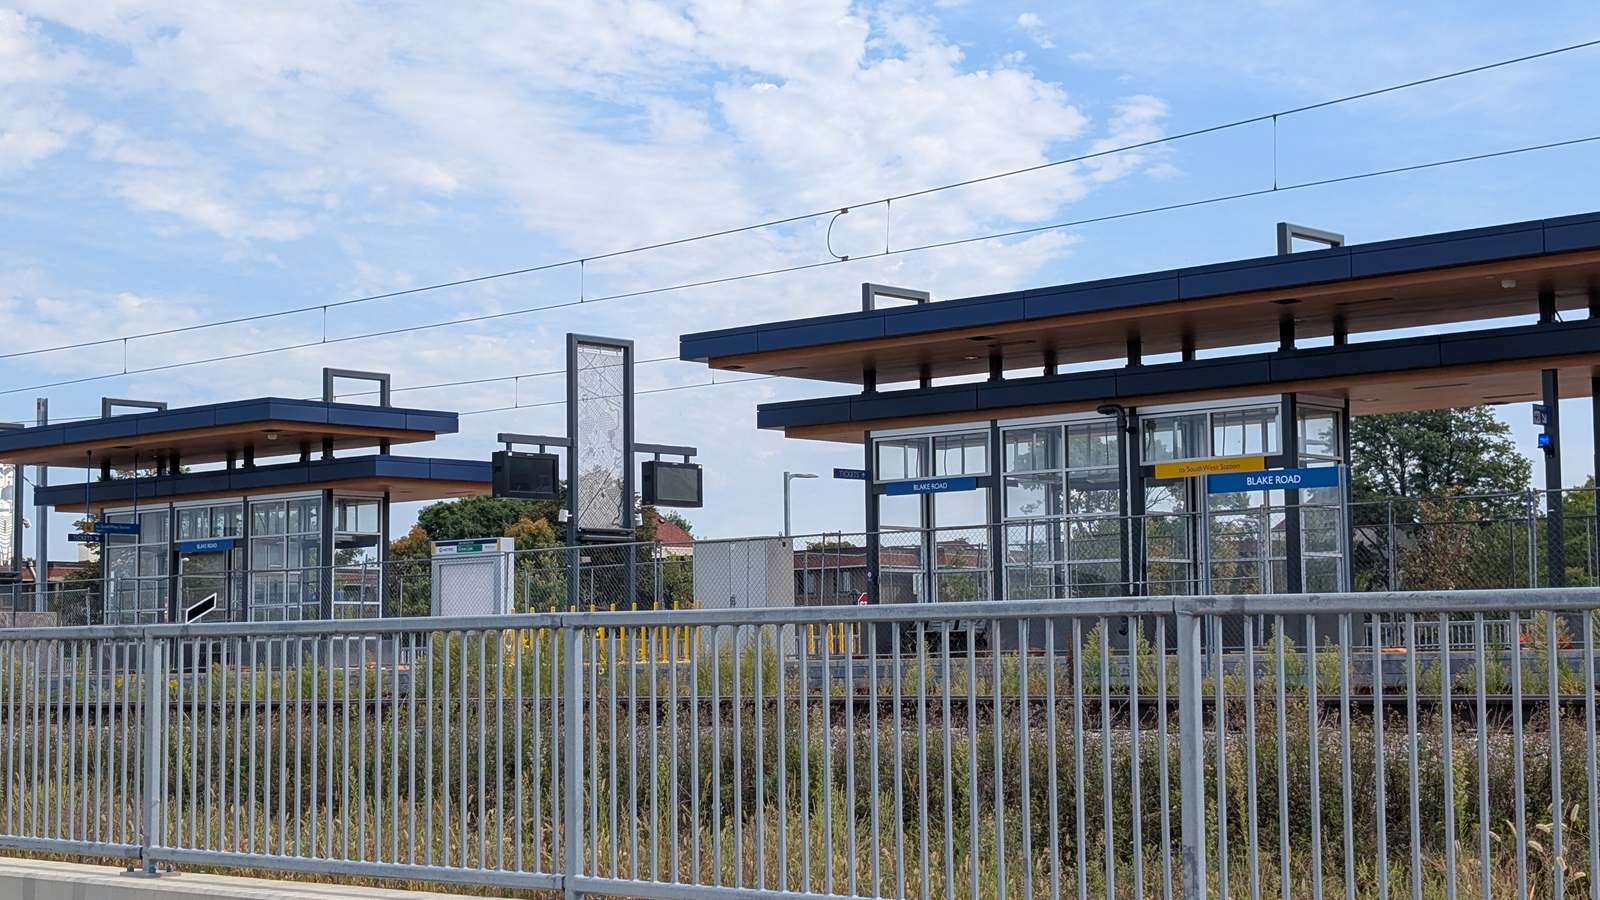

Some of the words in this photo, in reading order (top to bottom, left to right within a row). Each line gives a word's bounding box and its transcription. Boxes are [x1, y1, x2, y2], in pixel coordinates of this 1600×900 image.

[1246, 475, 1273, 486] BLAKE
[1275, 474, 1301, 485] ROAD
[913, 483, 930, 491] BLAKE
[931, 482, 948, 490] ROAD
